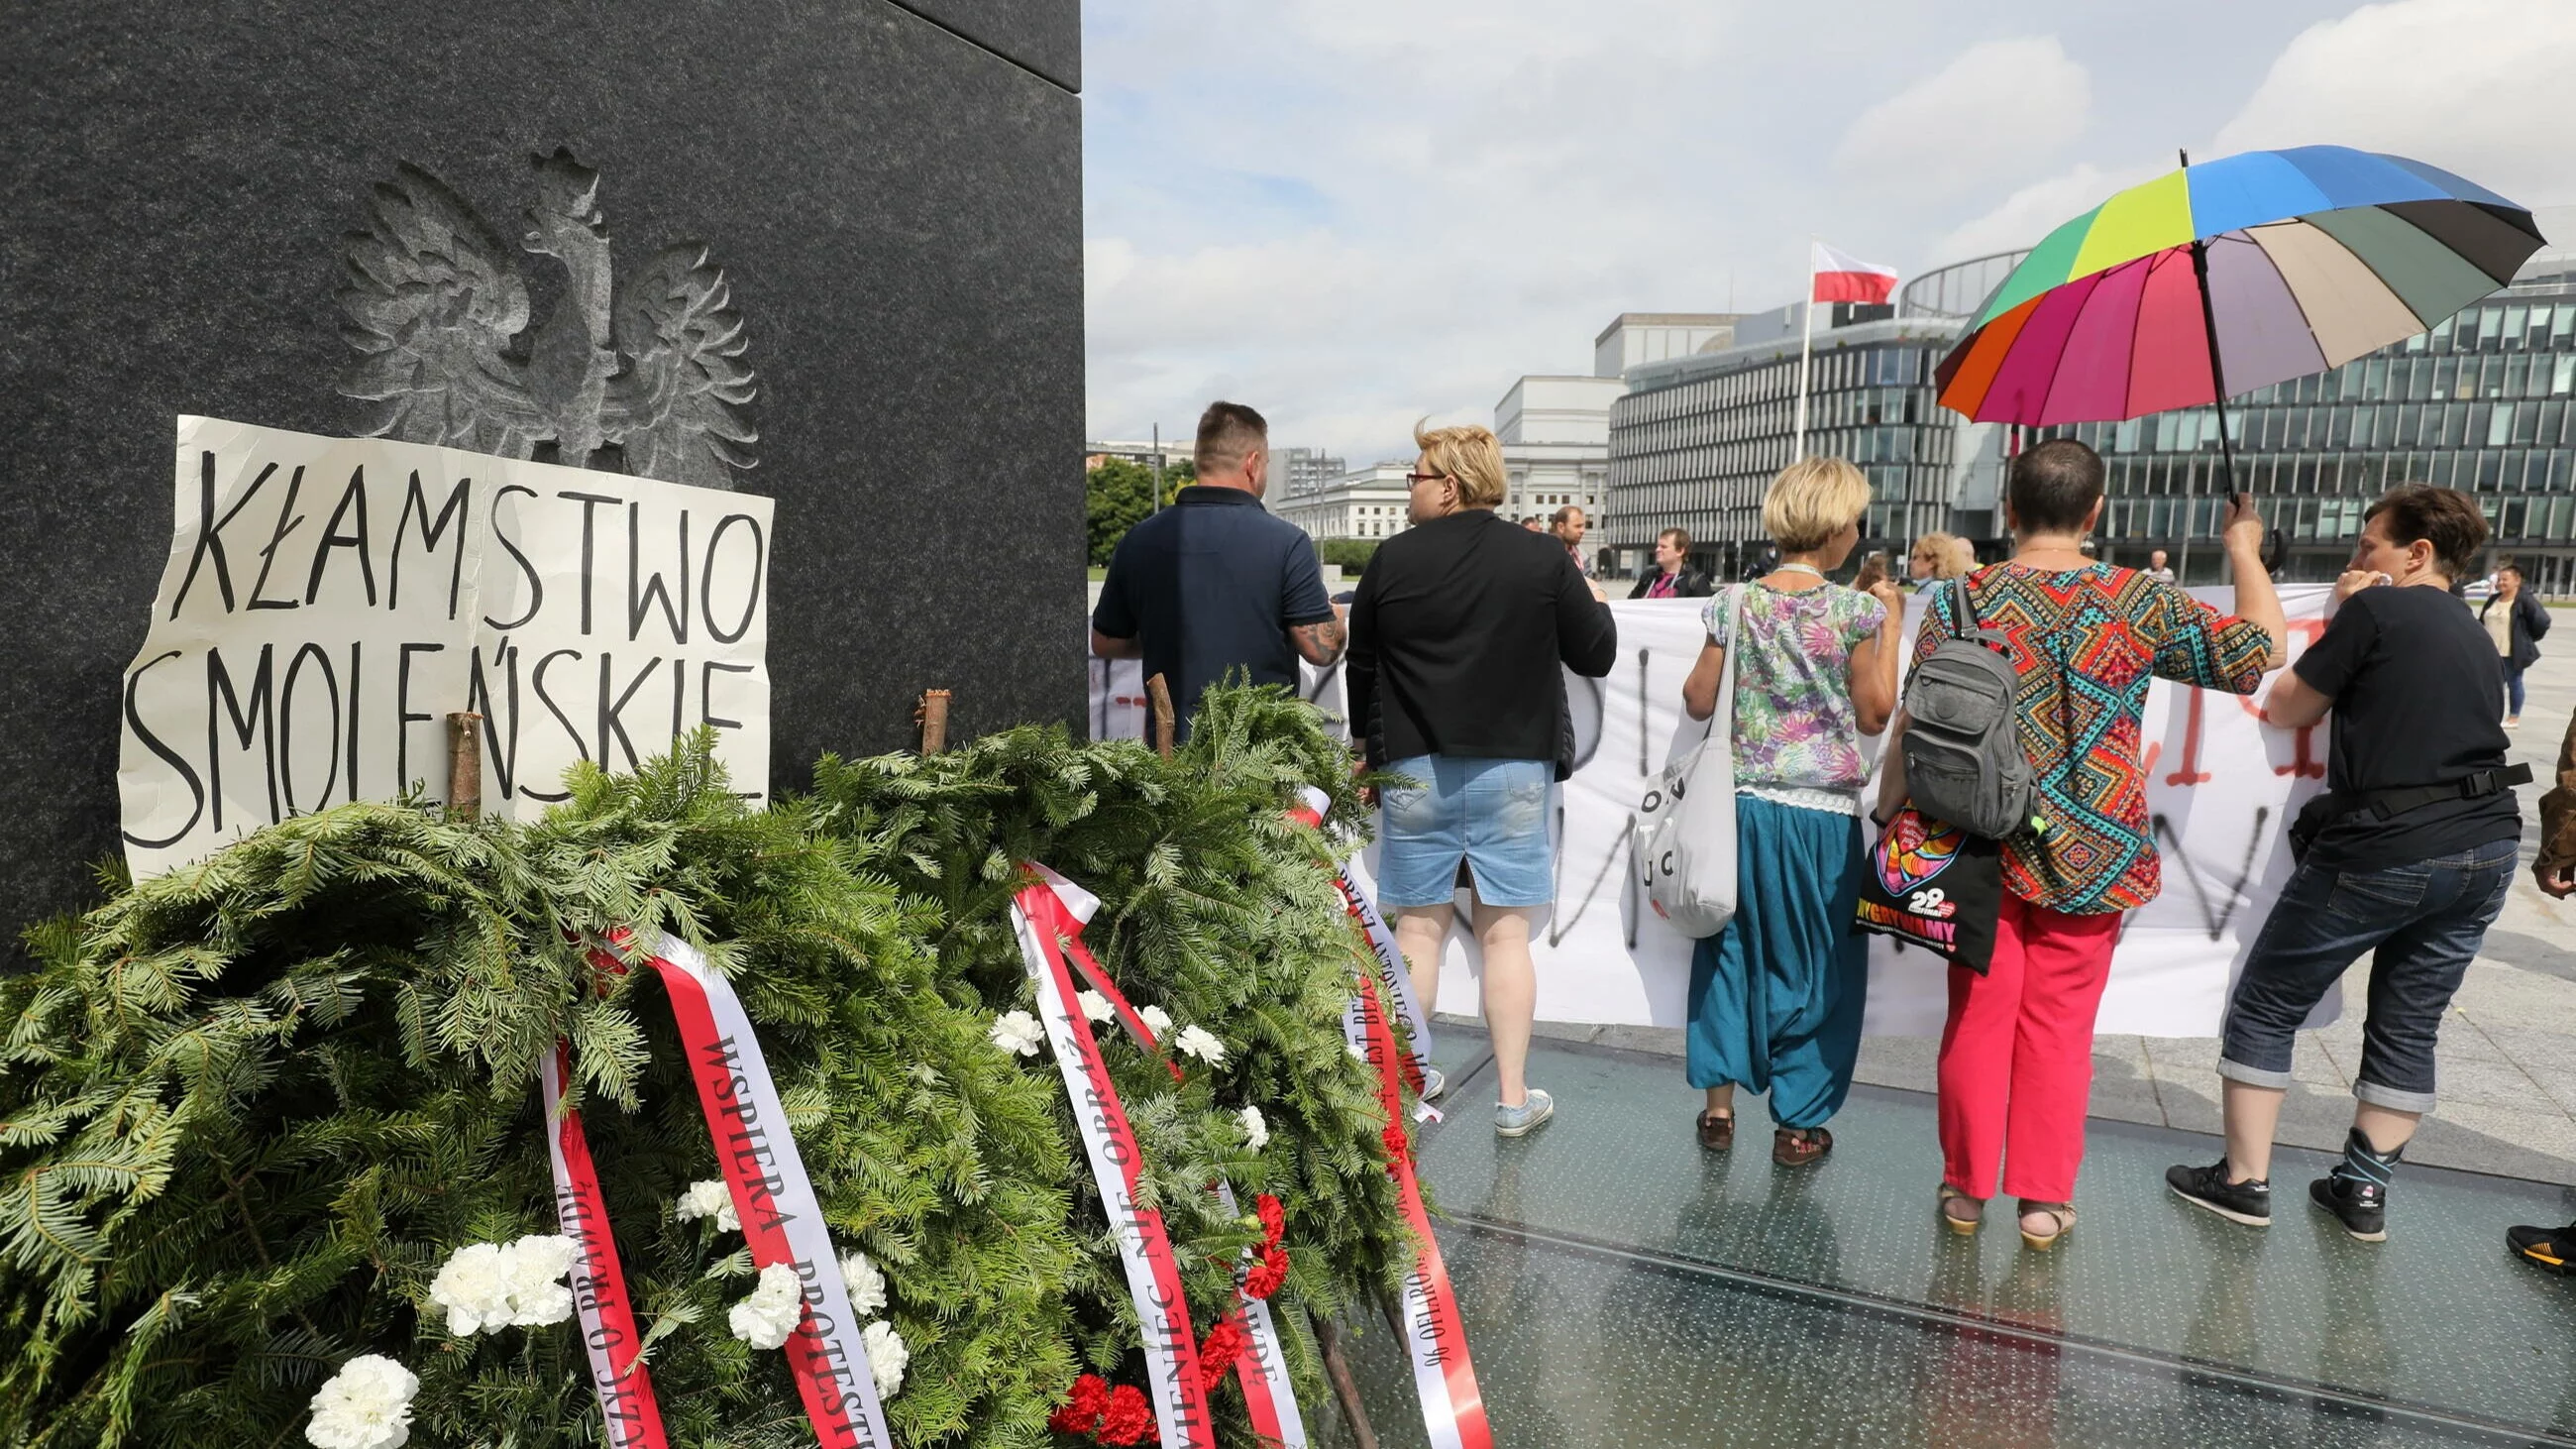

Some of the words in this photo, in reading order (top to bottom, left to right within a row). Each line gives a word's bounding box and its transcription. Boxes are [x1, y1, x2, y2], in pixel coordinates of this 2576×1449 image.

[169, 450, 763, 644] KŁAMSTWO
[123, 636, 763, 849] SMOLEŃSKIE
[1908, 887, 1945, 912] 29
[701, 1034, 799, 1234] WSPIERA
[1056, 1014, 1130, 1168] OBRAŻA
[556, 1180, 616, 1317] PRAWDĘ
[1116, 1191, 1161, 1260] NIE
[589, 1328, 623, 1351] O
[1424, 1346, 1451, 1368] 96
